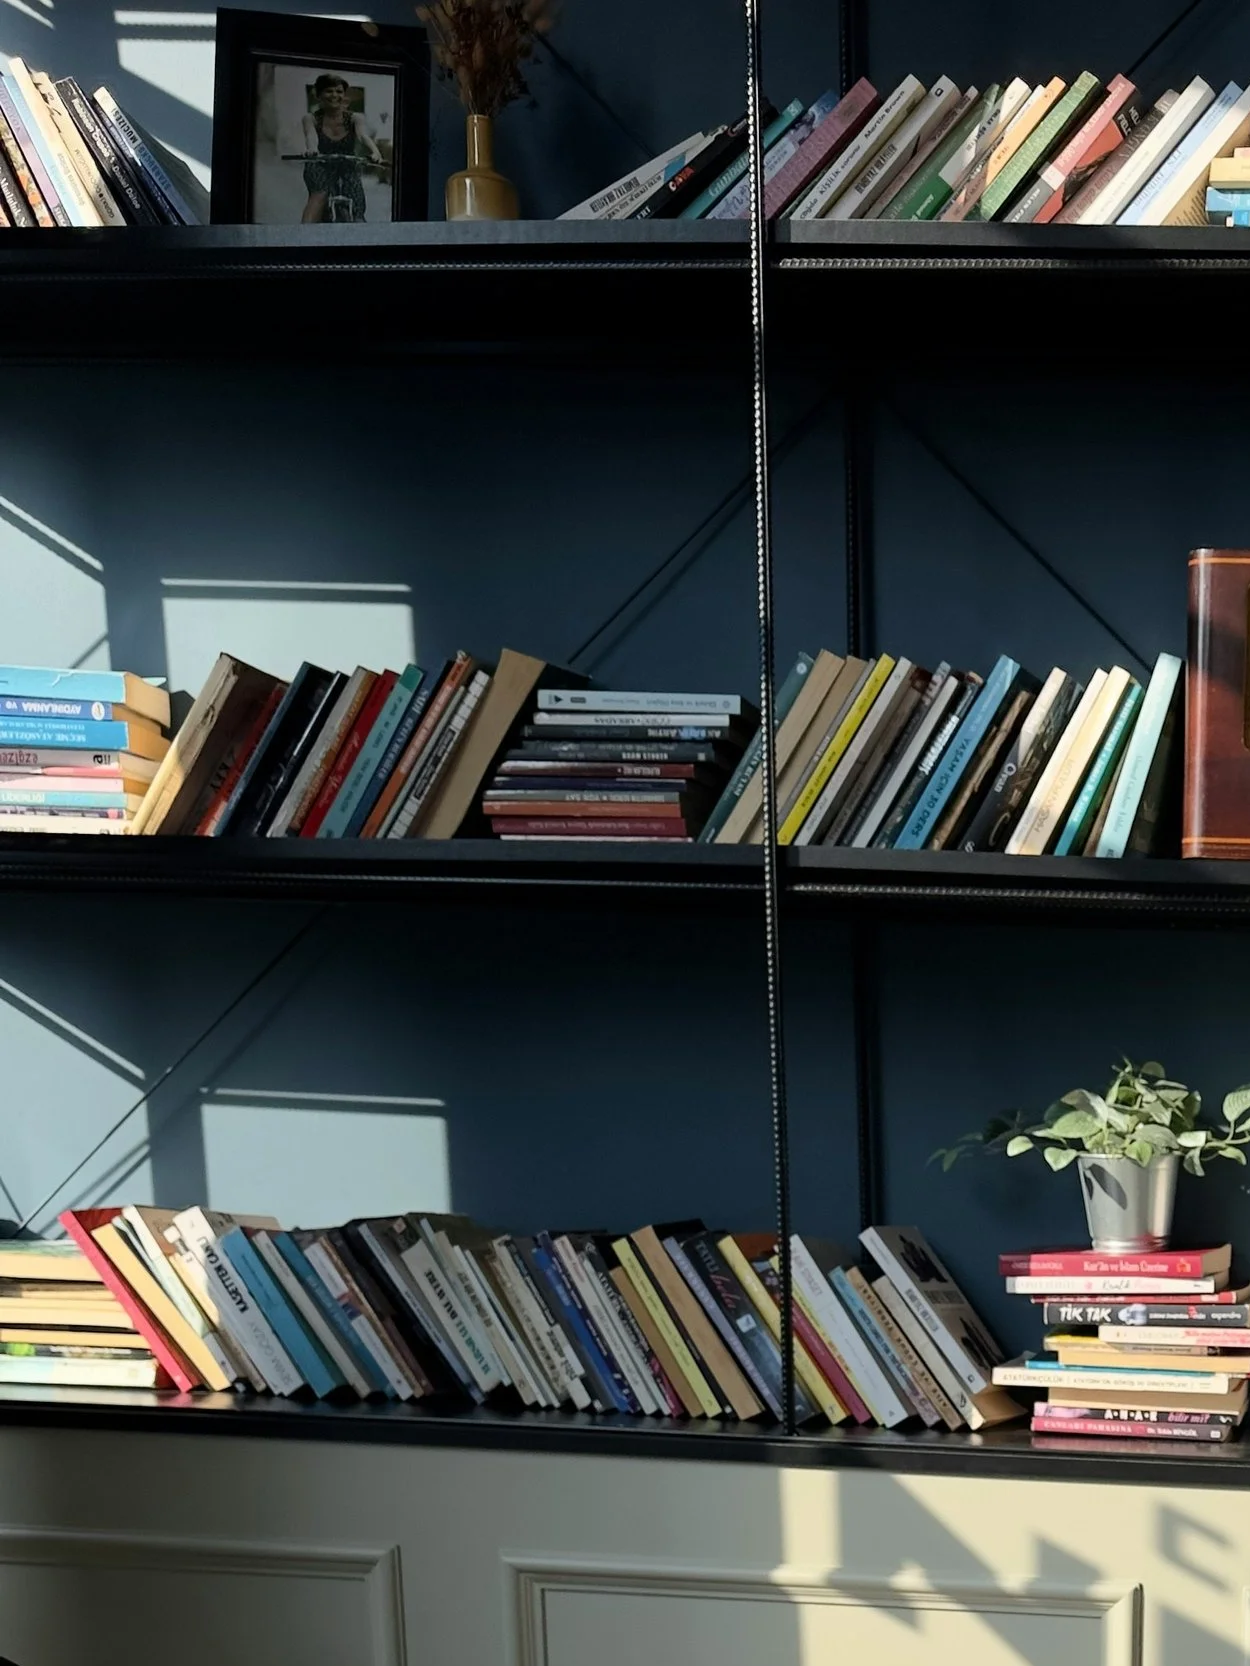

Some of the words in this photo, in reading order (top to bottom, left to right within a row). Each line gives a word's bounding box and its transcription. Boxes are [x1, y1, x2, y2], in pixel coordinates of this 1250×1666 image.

[862, 112, 887, 139] Martin
[883, 89, 906, 114] Brown
[111, 164, 129, 189] Daniel
[5, 700, 17, 709] ve
[945, 735, 972, 773] YAŞAM
[925, 793, 940, 810] 30
[909, 808, 931, 838] DERS
[212, 1262, 250, 1314] KASETTEN
[1058, 1302, 1083, 1321] TİK
[1085, 1306, 1111, 1322] TAK
